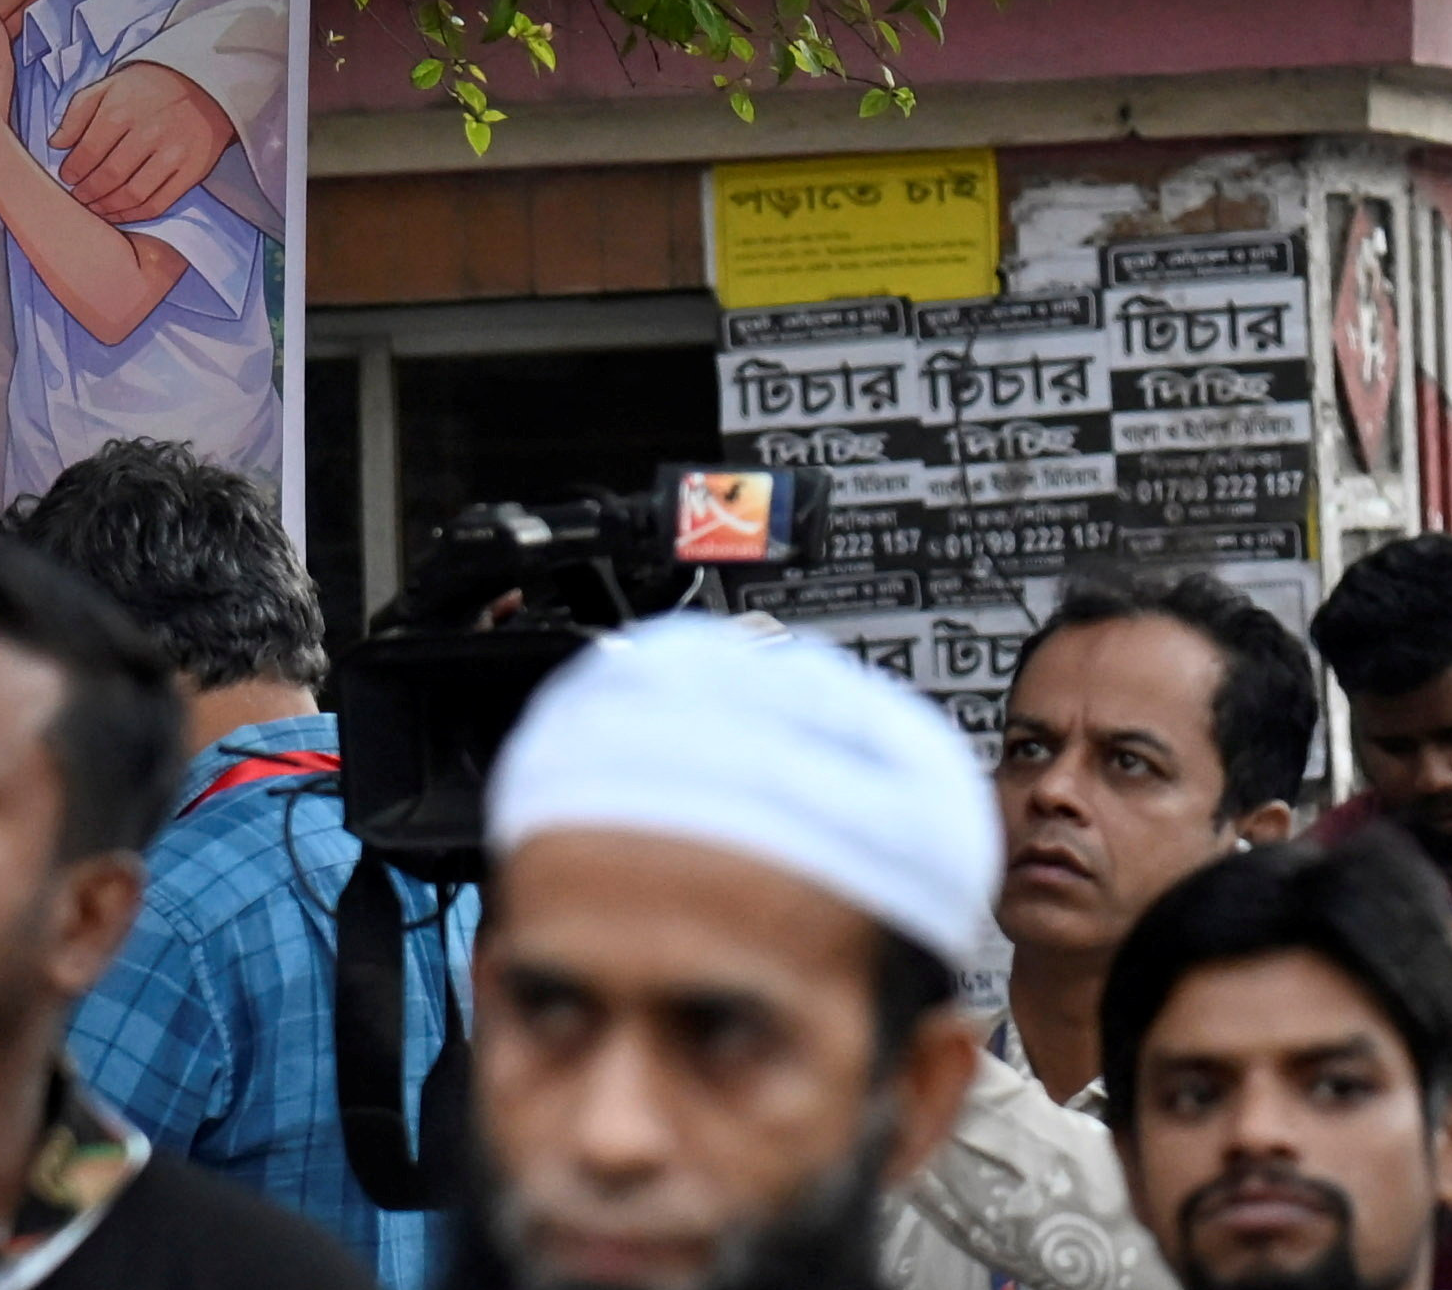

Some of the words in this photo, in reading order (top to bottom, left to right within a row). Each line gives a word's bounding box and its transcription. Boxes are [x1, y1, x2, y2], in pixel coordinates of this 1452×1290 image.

[730, 183, 883, 219] পড়াতে
[904, 169, 982, 205] চাই
[1115, 292, 1293, 357] টিচার
[732, 358, 907, 421] টিচার
[920, 349, 1096, 411] টিচার
[1136, 366, 1279, 409] দিচ্ছি
[752, 426, 892, 467] দিচ্ছি
[945, 420, 1084, 462] দিচ্ছি
[831, 534, 874, 558] 222
[1021, 524, 1066, 552] 222
